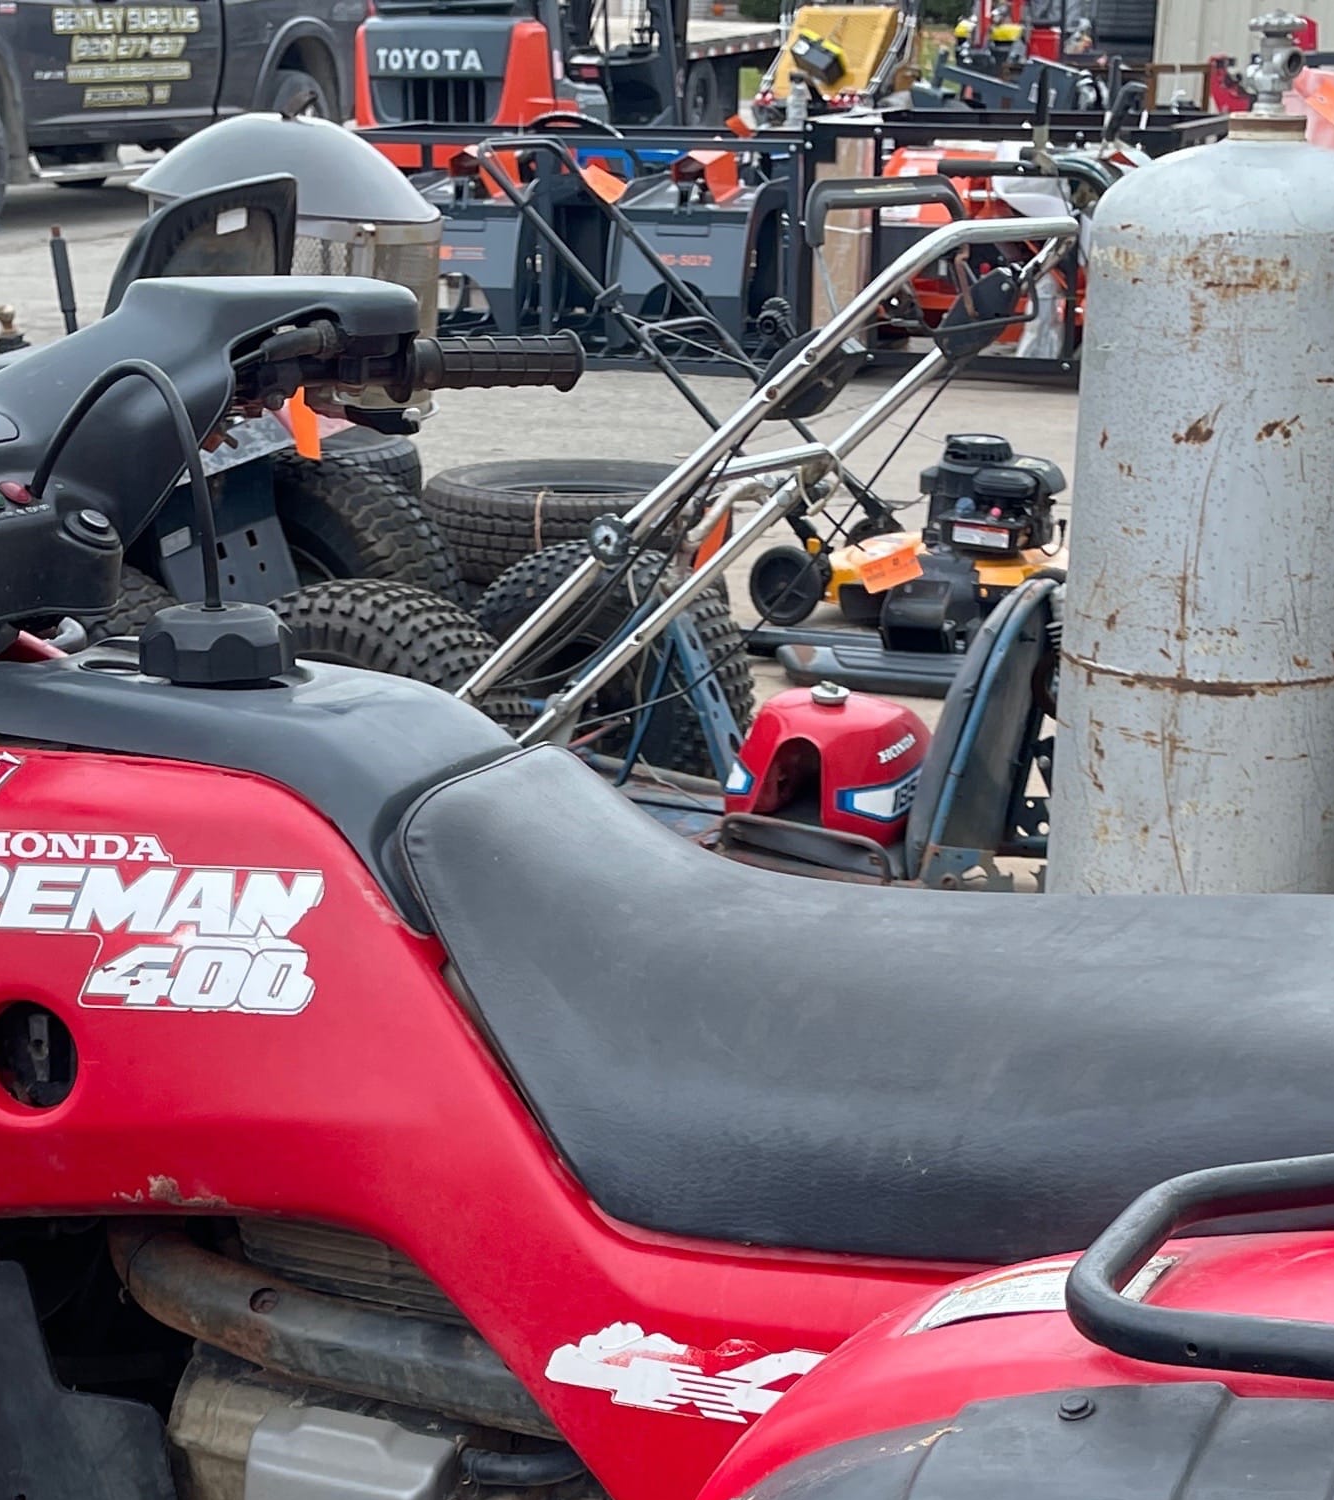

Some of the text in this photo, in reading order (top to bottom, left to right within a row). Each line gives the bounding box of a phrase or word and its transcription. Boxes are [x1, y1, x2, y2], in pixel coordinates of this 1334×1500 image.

[127, 7, 200, 32] SURPLUS
[376, 48, 483, 71] TOYOTA
[877, 733, 916, 764] HONDA
[84, 945, 315, 1013] 400
